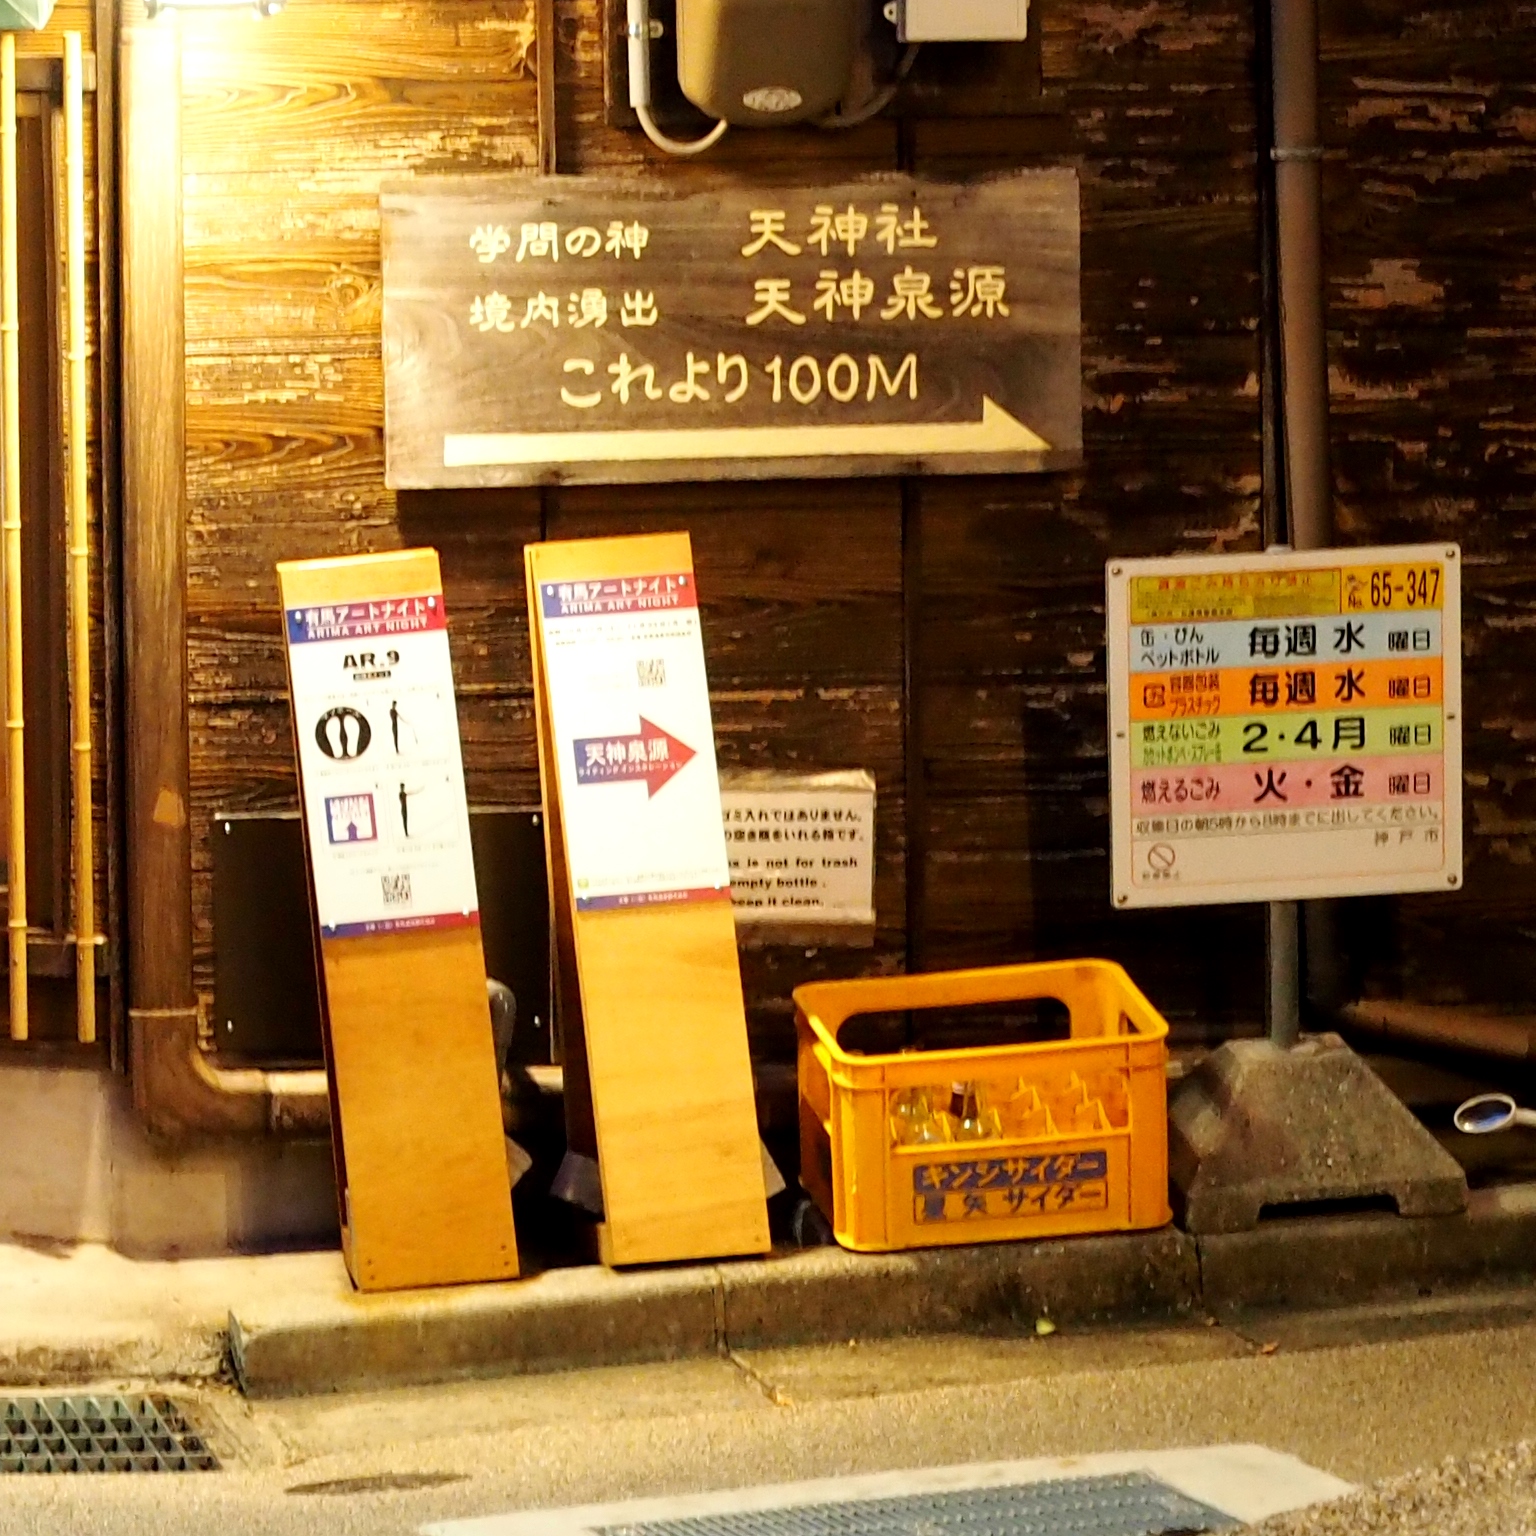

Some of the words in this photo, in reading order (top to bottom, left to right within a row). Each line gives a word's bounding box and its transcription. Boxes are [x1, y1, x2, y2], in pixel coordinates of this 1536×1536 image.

[469, 220, 649, 263] 学問の神
[741, 203, 938, 258] 天神社
[745, 265, 1010, 327] 天神泉源
[469, 287, 658, 333] 境内湧出
[558, 577, 676, 602] 有馬アートナイト
[1371, 568, 1440, 606] 65-347
[305, 598, 425, 627] 有馬アートナイト
[561, 601, 602, 615] ARIMA
[608, 598, 632, 612] ART
[637, 593, 679, 609] NIGHT
[307, 624, 349, 640] ARIMA
[355, 621, 380, 635] ART
[385, 615, 427, 632] NIGHT
[343, 650, 400, 670] AR.9
[1140, 647, 1220, 667] ペットボトル
[1143, 722, 1221, 743] 燃えないごみ
[585, 737, 669, 768] 天神泉源
[1141, 777, 1221, 805] 燃えるごみ
[747, 856, 759, 868] is
[766, 857, 788, 869] not
[796, 856, 813, 868] for
[821, 855, 858, 868] trash
[729, 877, 772, 891] empty
